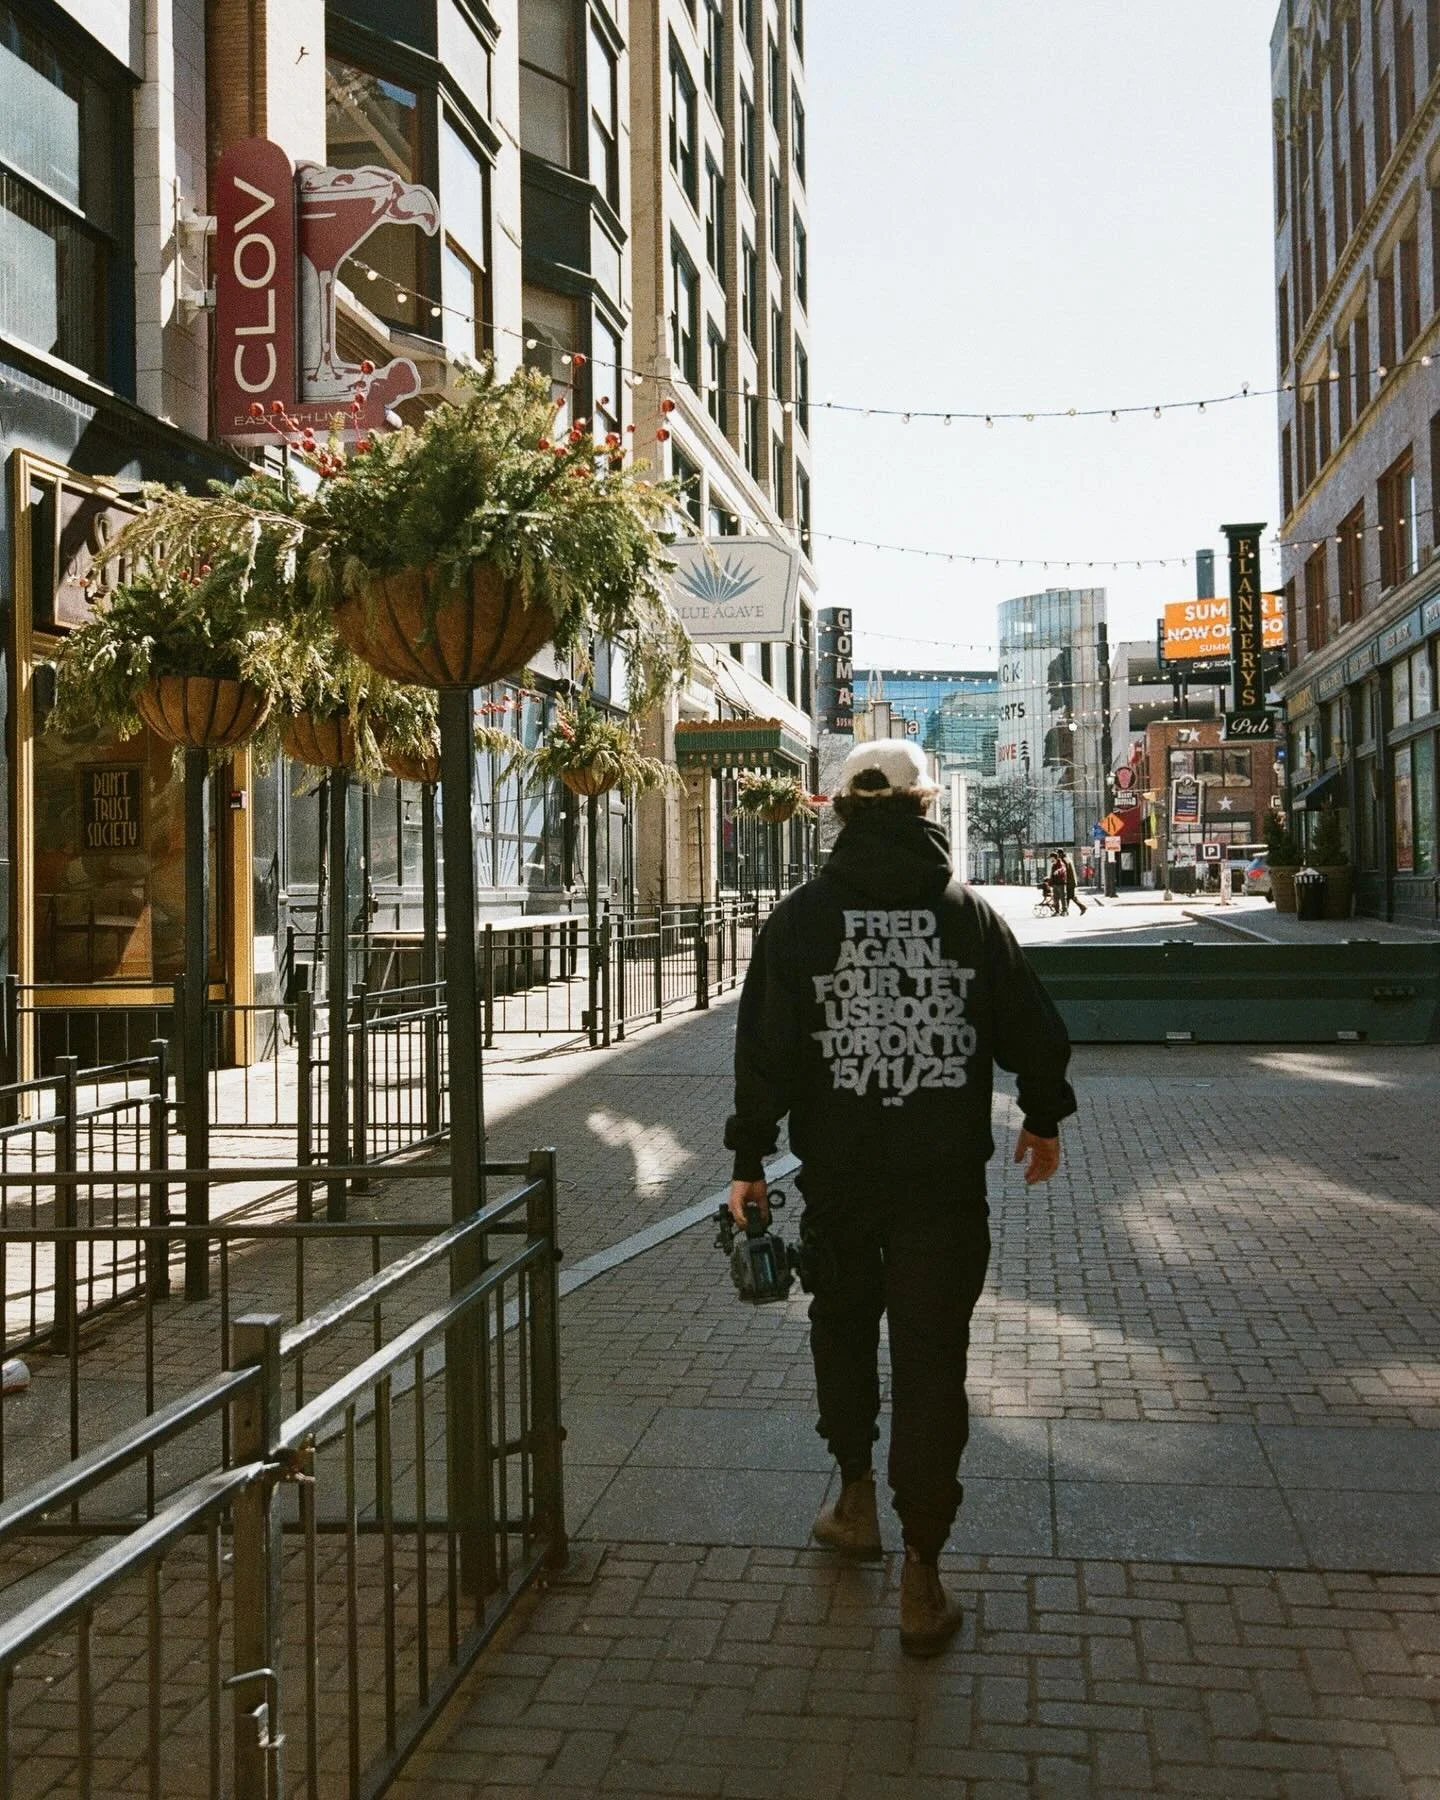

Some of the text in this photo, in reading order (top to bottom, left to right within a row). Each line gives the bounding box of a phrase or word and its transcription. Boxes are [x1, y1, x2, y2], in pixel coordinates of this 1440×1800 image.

[233, 176, 276, 393] CLOV
[234, 415, 275, 426] EAST
[712, 605, 765, 619] AGAVE
[1167, 624, 1210, 642] NOW
[835, 610, 853, 706] GOMA
[1229, 718, 1270, 735] Pub
[92, 796, 131, 821] TRUST
[87, 821, 137, 847] SOCIETY
[842, 909, 937, 938] FRED
[812, 967, 976, 1004] FOUR TET
[810, 1024, 977, 1058] TORONTO
[830, 1053, 968, 1096] 15/11/25
